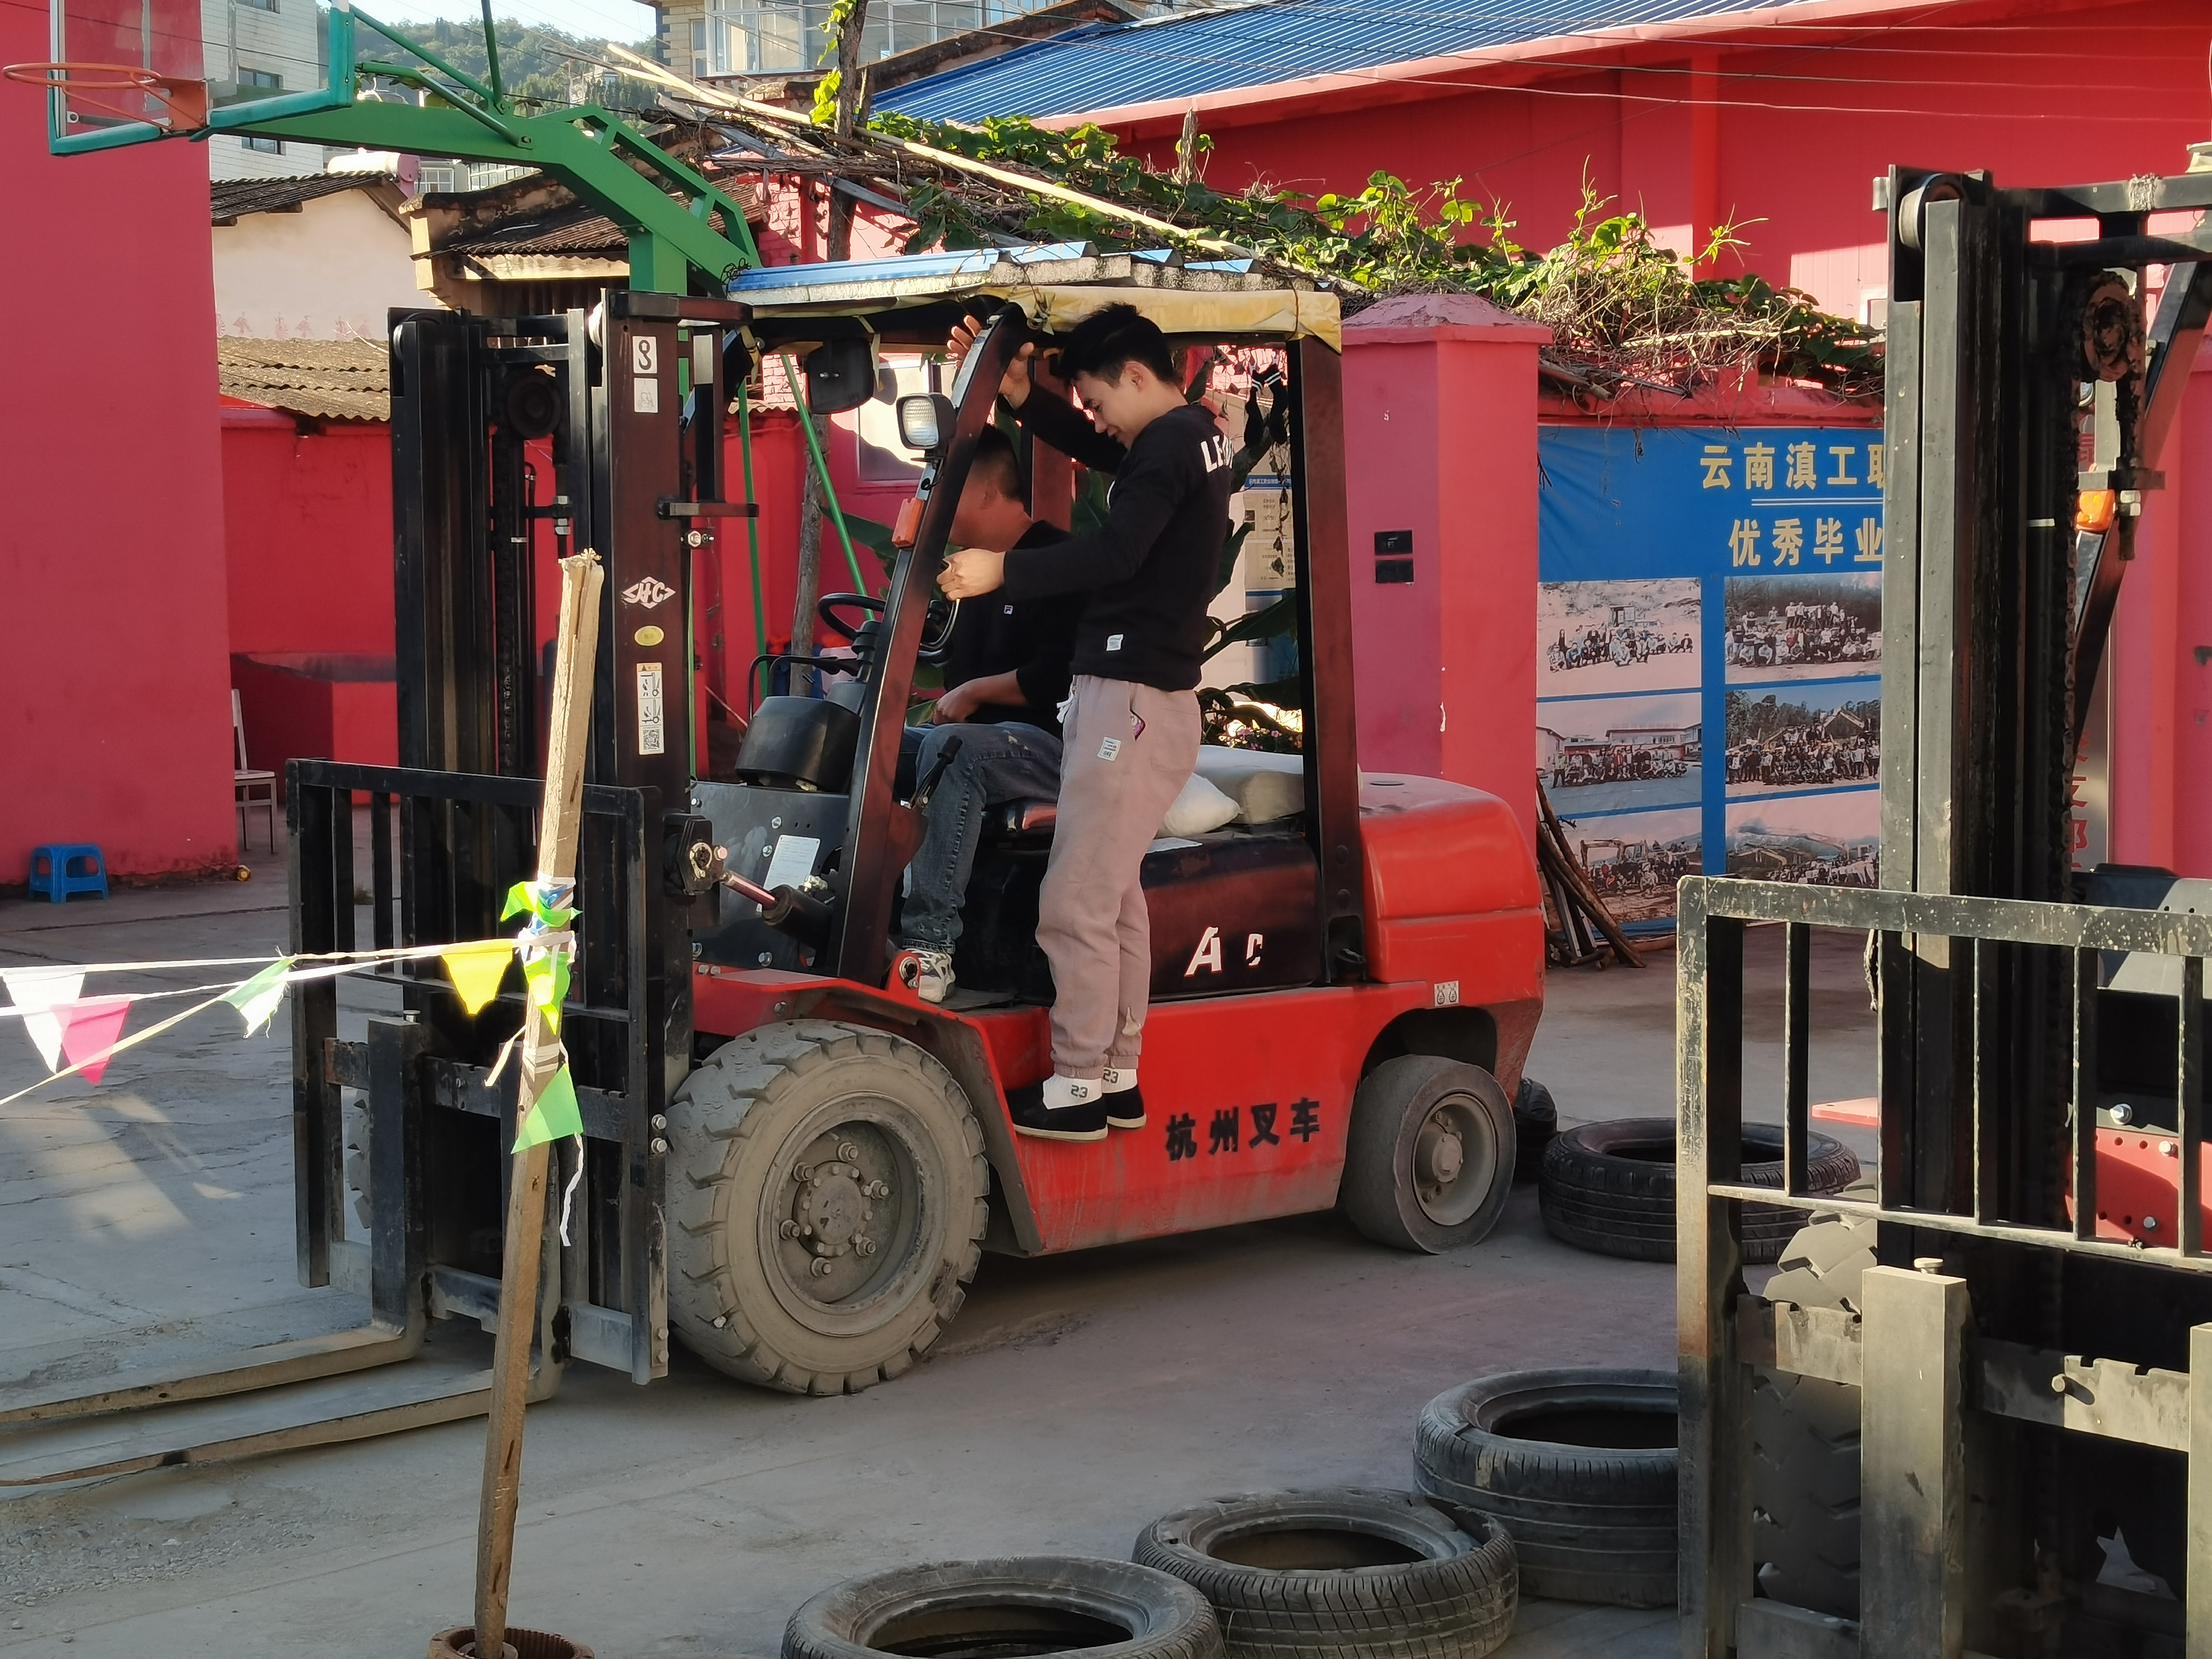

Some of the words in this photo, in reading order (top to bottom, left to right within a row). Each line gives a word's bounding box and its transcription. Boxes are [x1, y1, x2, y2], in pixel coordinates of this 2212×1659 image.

[1729, 517, 1884, 567] 优秀毕业
[1070, 1084, 1088, 1098] 23
[1103, 1069, 1118, 1084] 23
[1166, 1097, 1320, 1162] 杭州叉车
